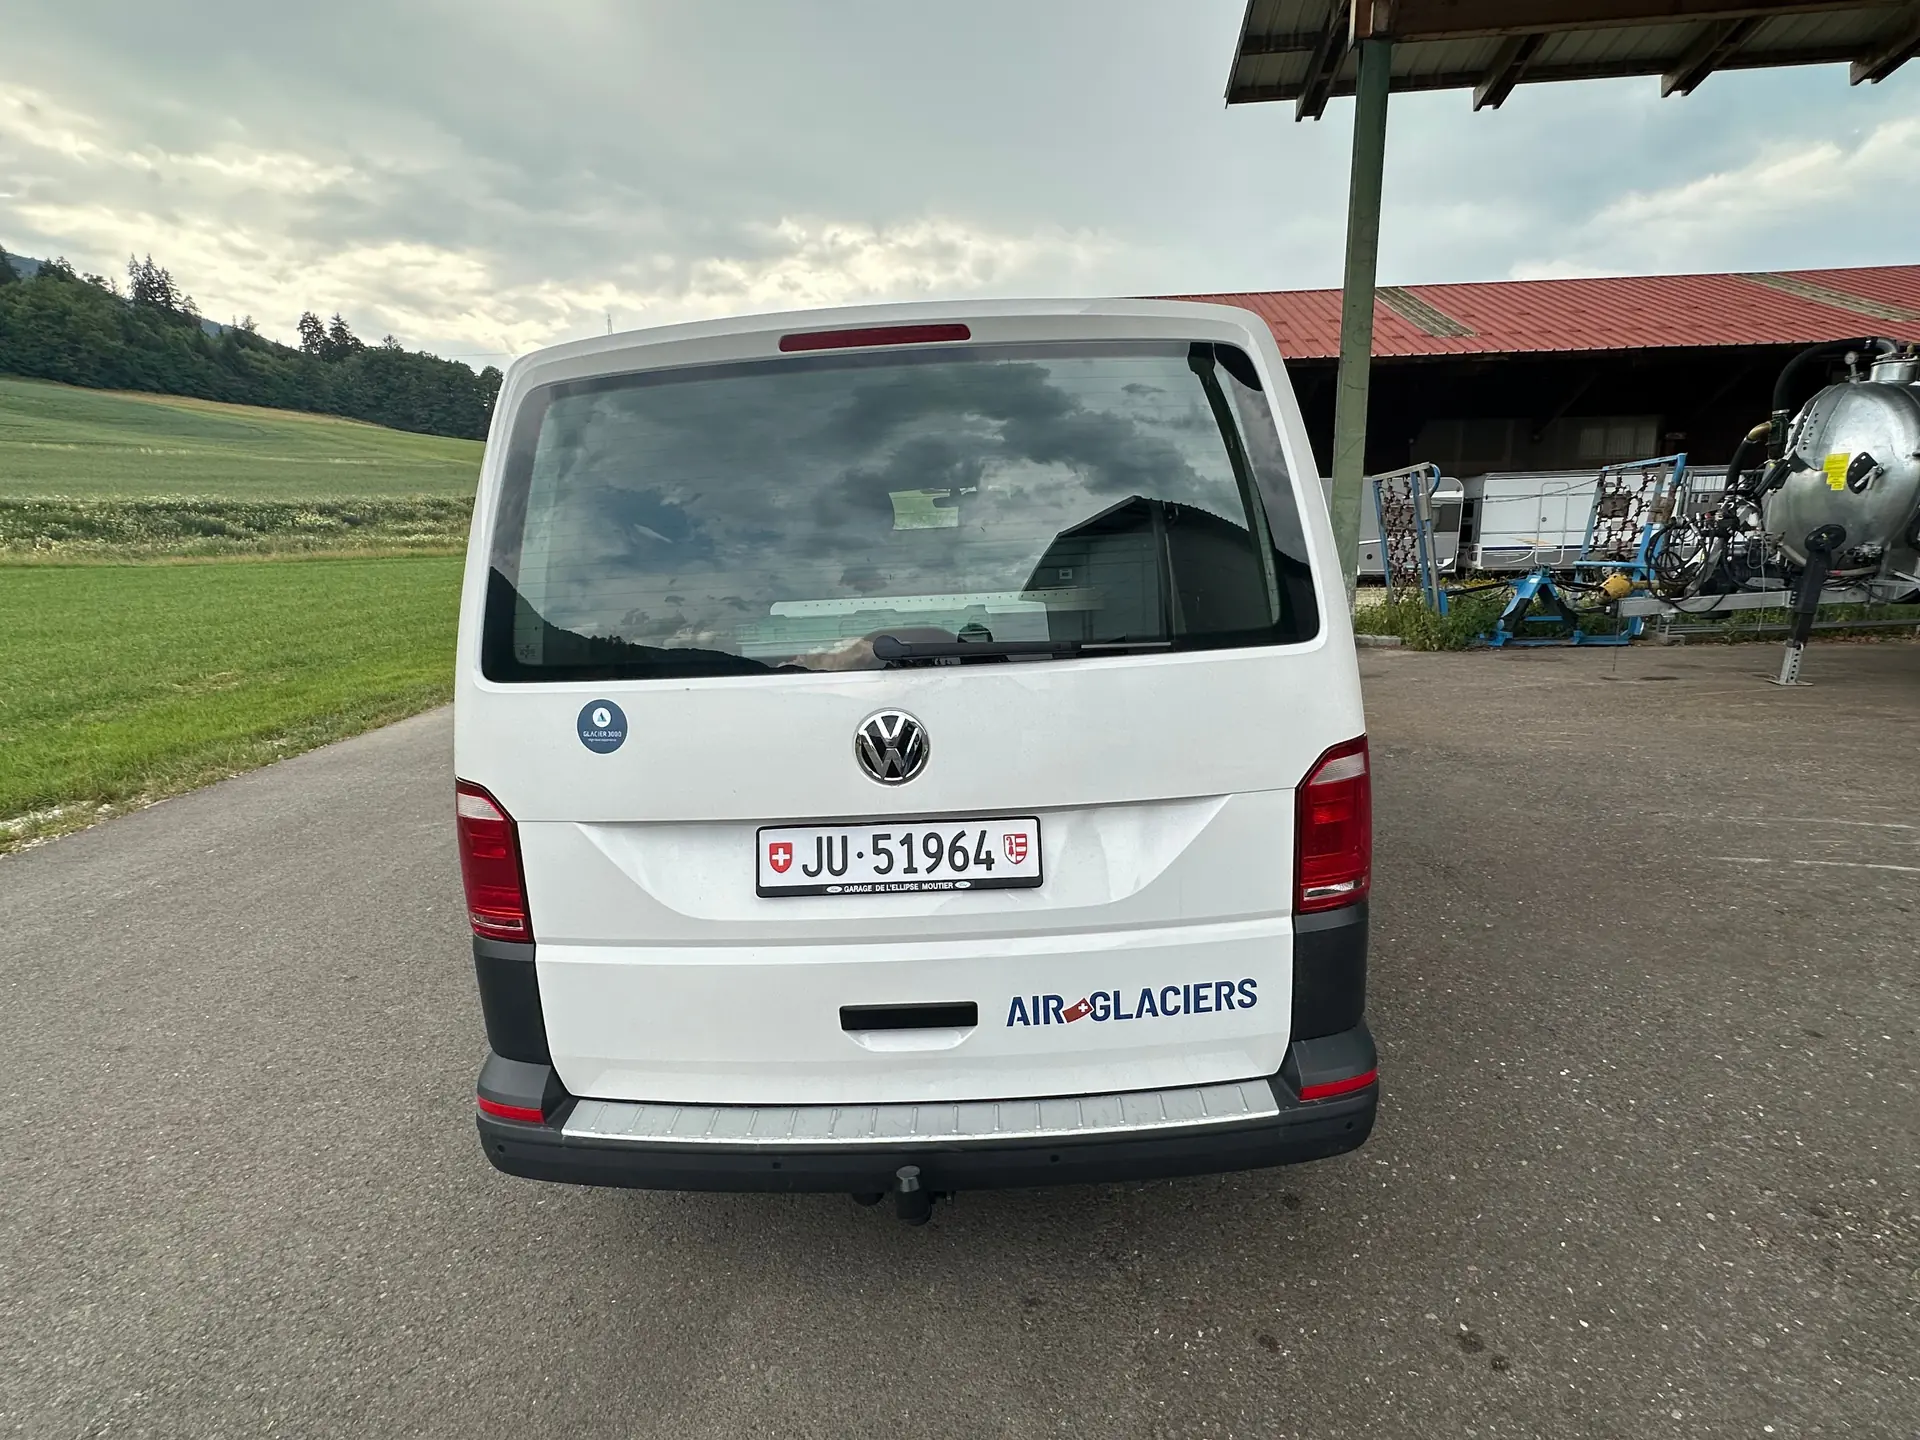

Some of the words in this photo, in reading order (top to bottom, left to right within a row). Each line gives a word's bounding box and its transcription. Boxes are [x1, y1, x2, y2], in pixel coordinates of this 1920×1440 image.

[843, 884, 873, 893] GARAGE
[875, 883, 885, 892] DE
[886, 882, 919, 892] L'ELLIPSE
[921, 881, 954, 890] MOUTIER
[1006, 994, 1065, 1027] AIR
[1089, 978, 1258, 1022] GLACIERS
